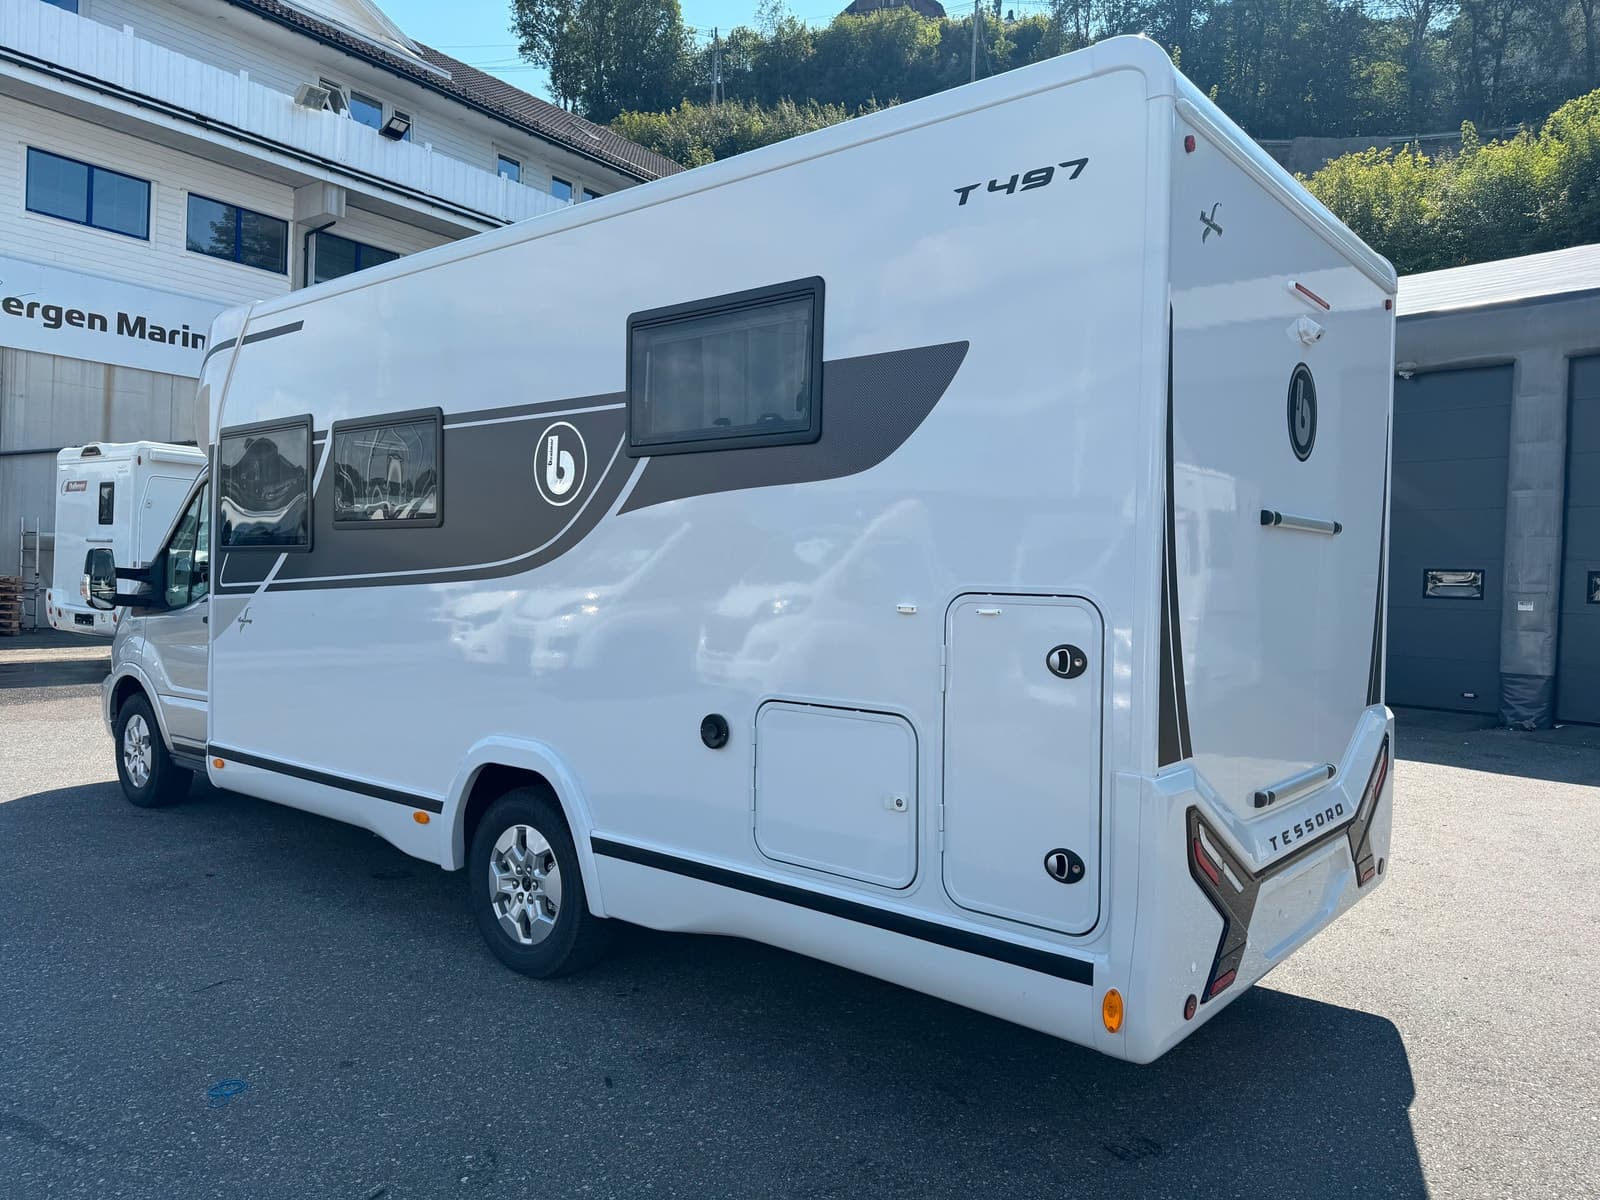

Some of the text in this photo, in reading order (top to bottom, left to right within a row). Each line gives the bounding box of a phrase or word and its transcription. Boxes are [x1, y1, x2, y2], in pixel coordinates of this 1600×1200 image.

[2, 296, 207, 351] ergen Marin
[1269, 803, 1344, 851] TESSORO
